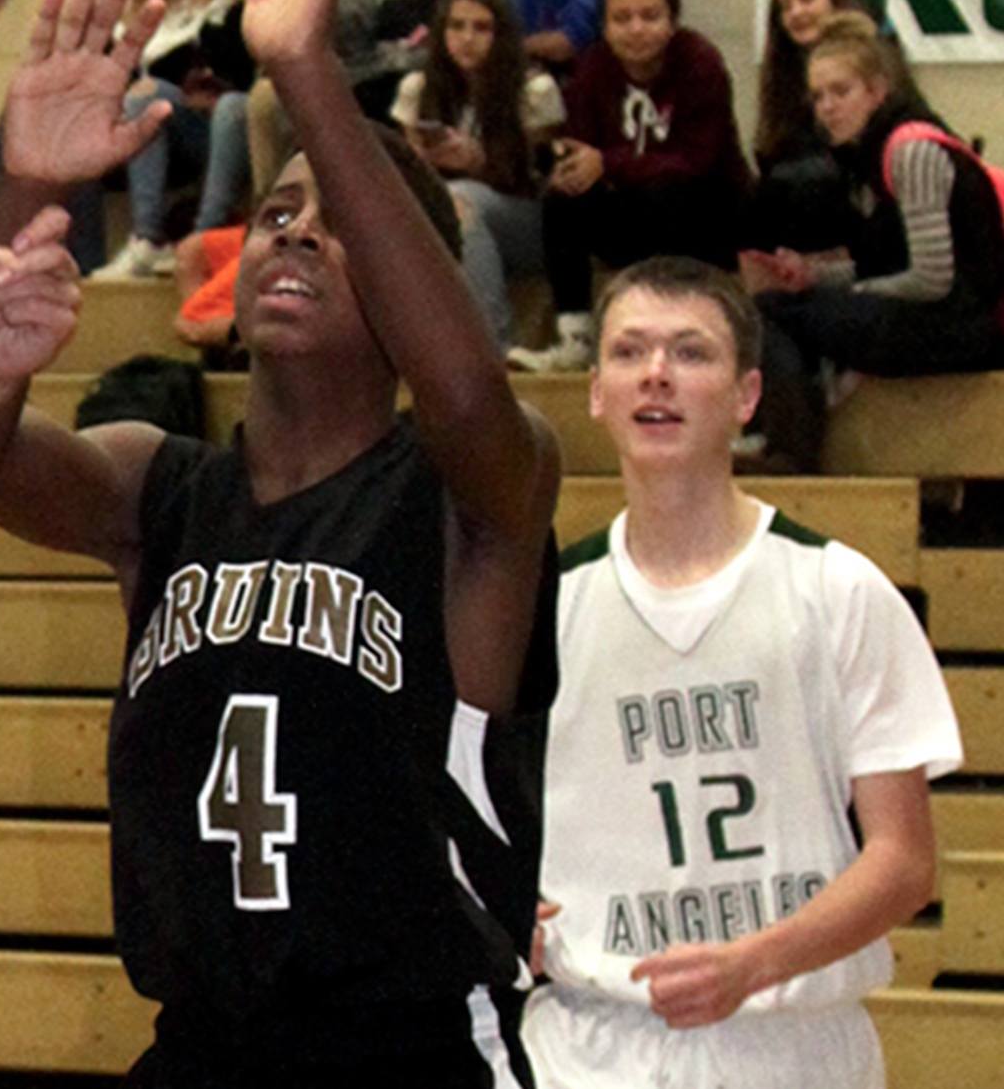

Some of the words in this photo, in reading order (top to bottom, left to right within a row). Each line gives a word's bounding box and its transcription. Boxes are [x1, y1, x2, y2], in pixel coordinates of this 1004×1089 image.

[616, 680, 760, 764] PORT
[198, 694, 297, 911] 4
[651, 773, 765, 868] 12
